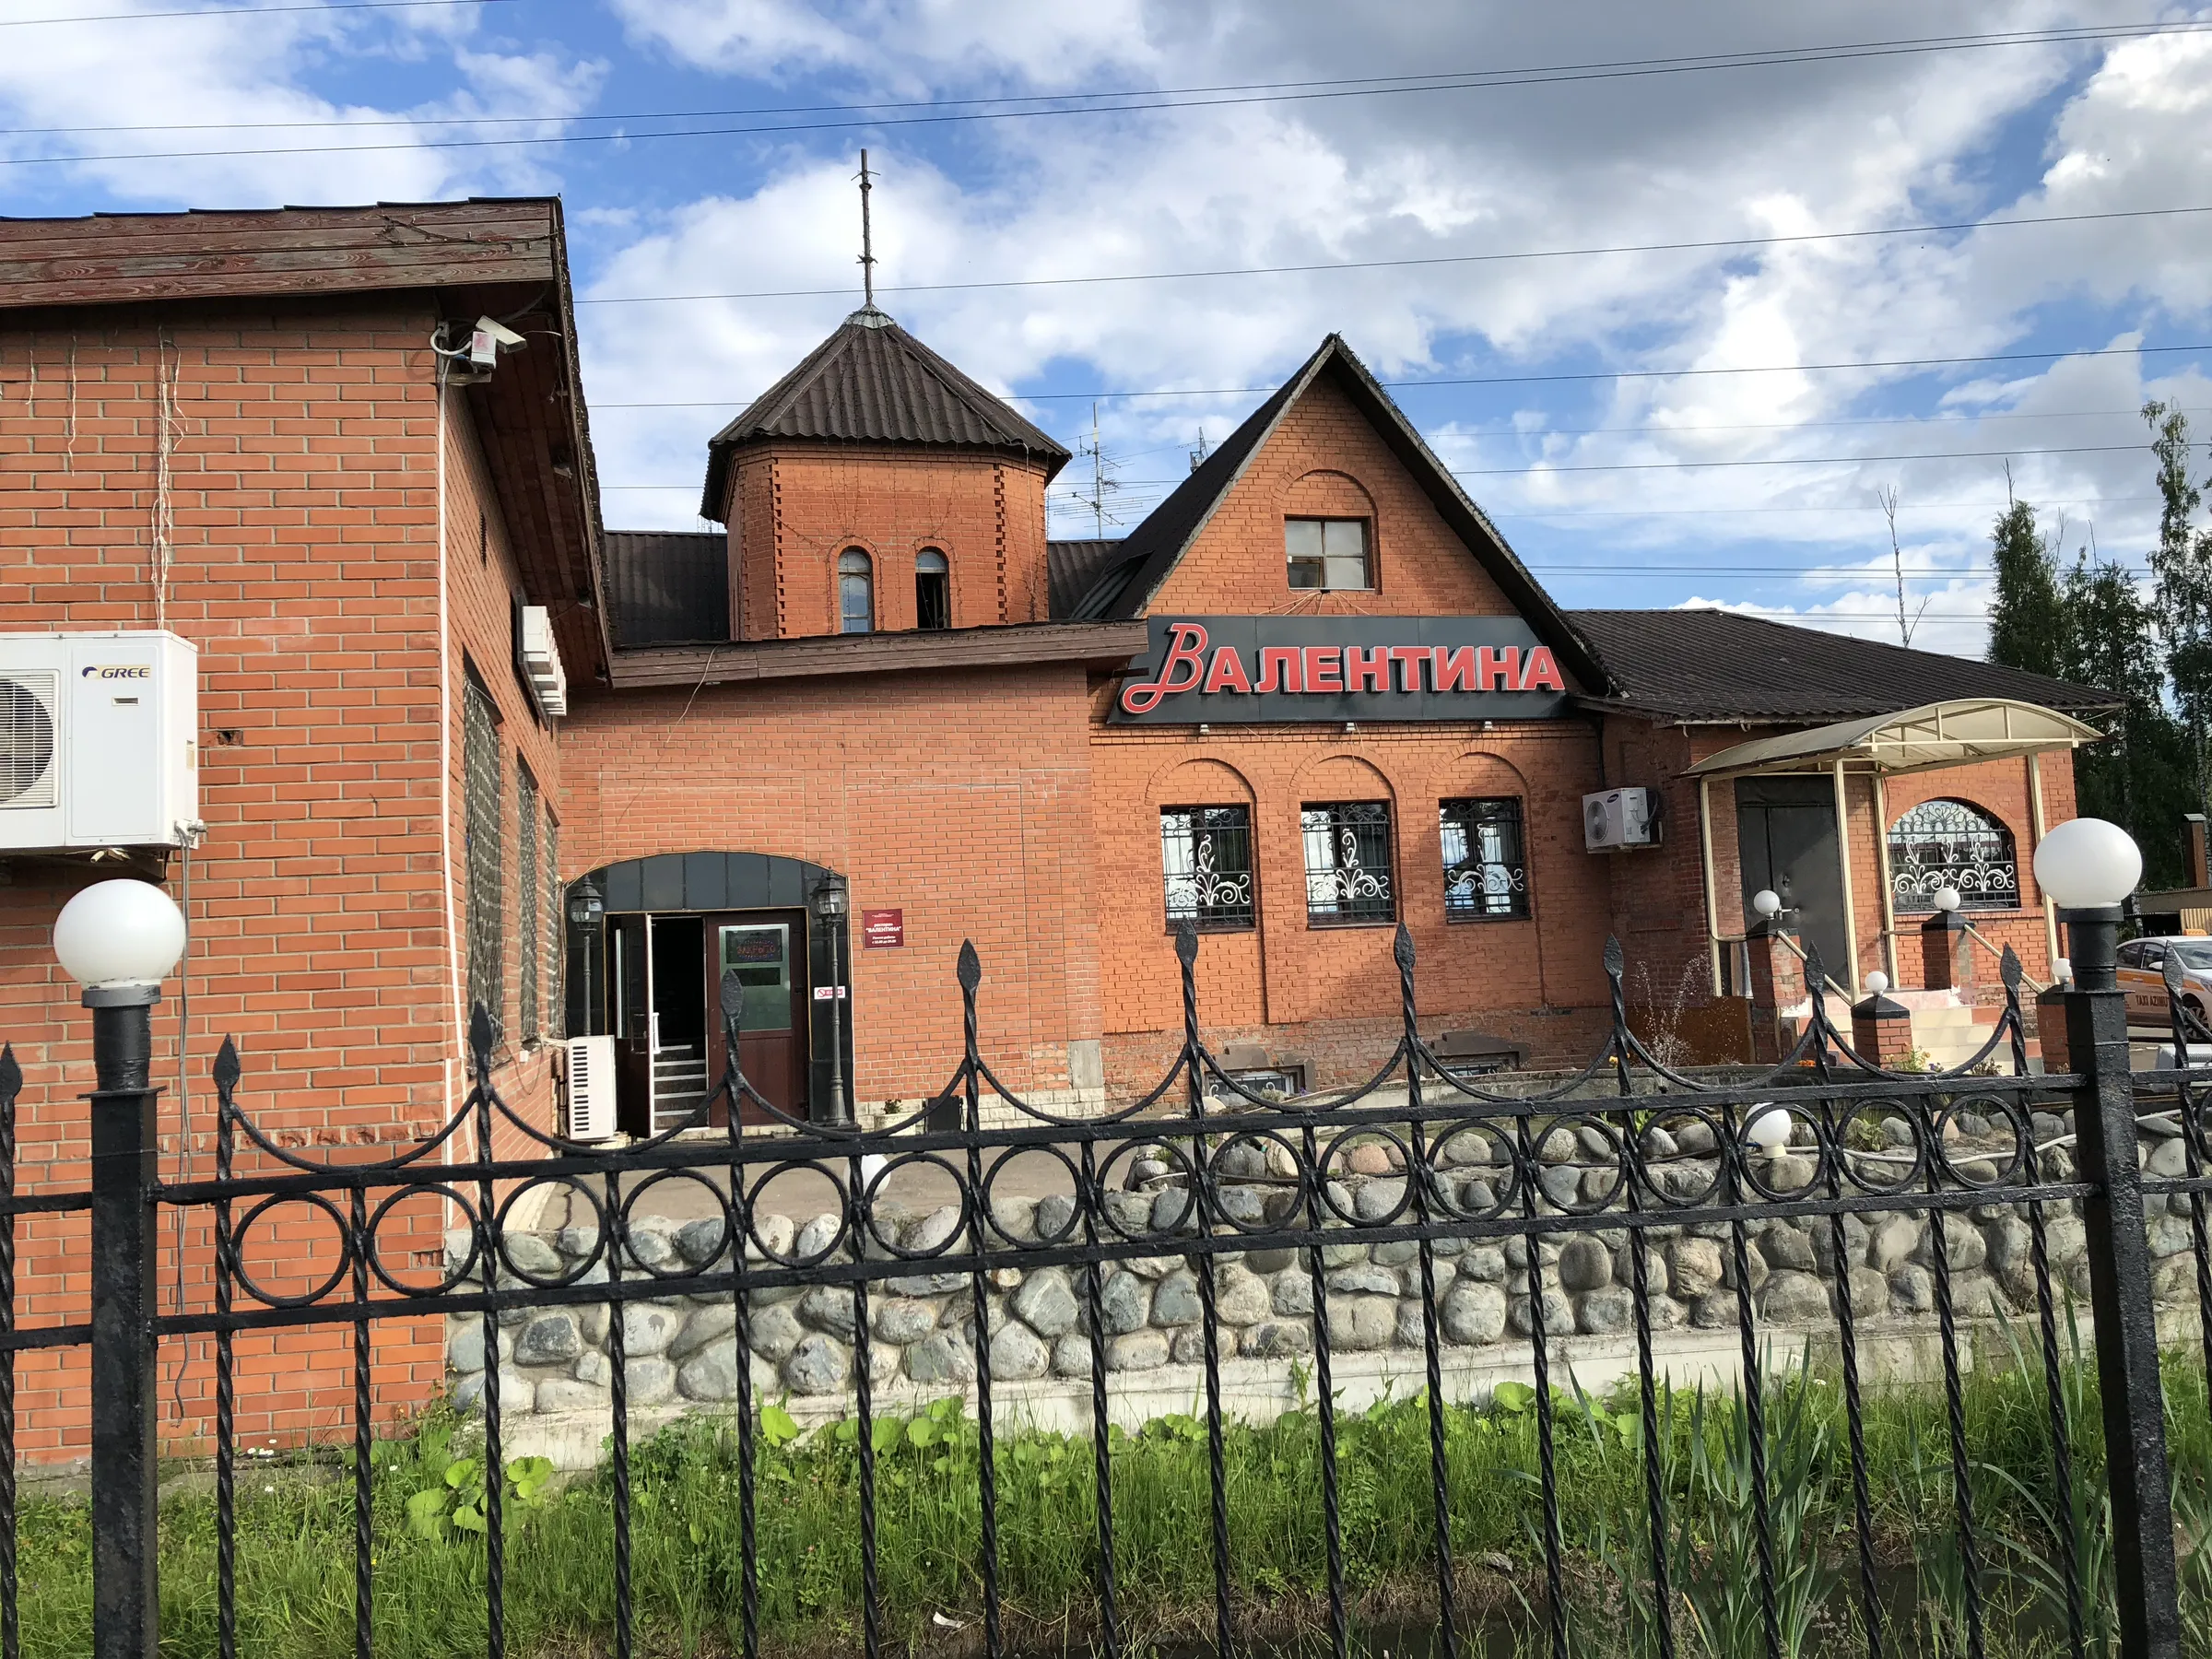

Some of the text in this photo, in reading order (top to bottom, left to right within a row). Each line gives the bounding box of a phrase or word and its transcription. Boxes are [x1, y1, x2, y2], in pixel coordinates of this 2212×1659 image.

[101, 667, 150, 678] GREE
[1121, 622, 1566, 714] ВАЛЕНТИНА
[2136, 995, 2148, 1006] TAXI
